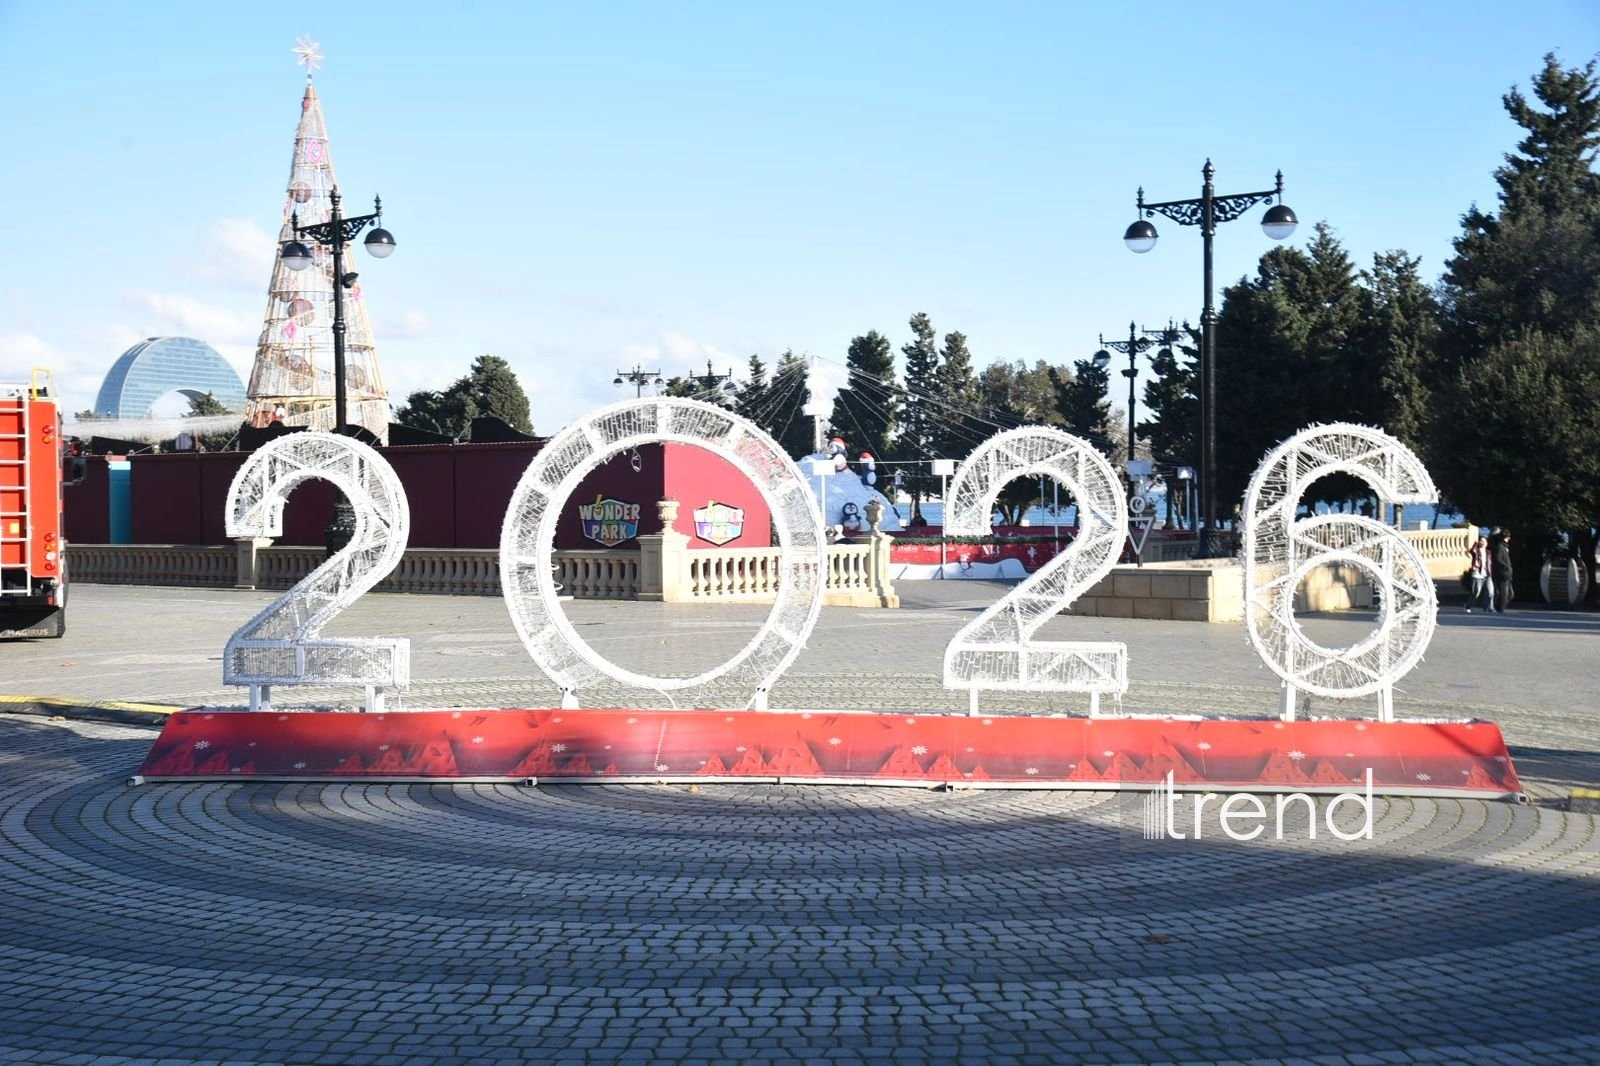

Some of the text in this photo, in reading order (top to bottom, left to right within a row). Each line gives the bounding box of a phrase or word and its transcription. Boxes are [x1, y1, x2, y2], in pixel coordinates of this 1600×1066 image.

[579, 504, 640, 520] WONDER
[592, 525, 627, 539] PARK
[223, 396, 1439, 699] 2026
